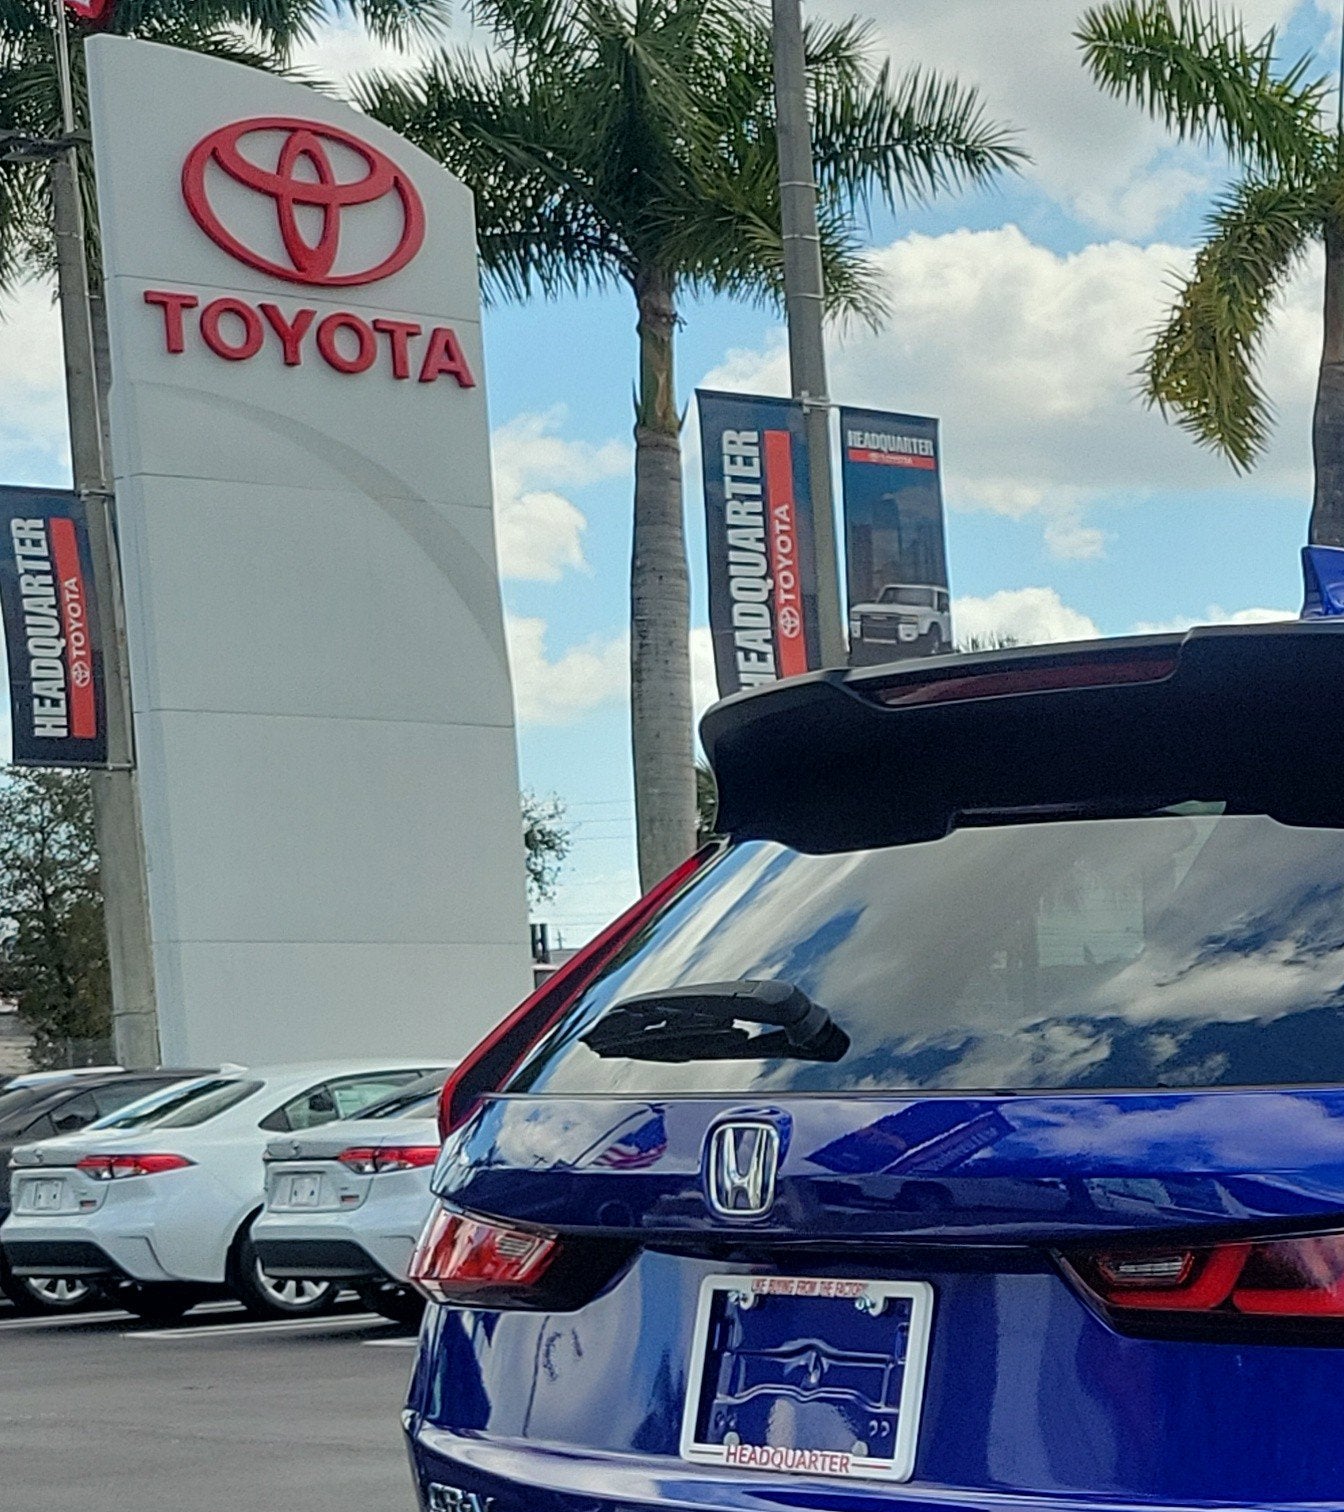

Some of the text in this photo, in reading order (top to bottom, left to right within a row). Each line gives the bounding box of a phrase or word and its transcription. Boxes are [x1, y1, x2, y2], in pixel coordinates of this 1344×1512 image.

[143, 290, 475, 389] TOYOTA
[847, 430, 934, 456] HEADQUARTER
[774, 504, 796, 604] TOYOTA
[10, 517, 68, 738] HEADQUARTER
[64, 576, 87, 660] TOYOTA
[725, 1445, 850, 1473] HEADQUARTER
